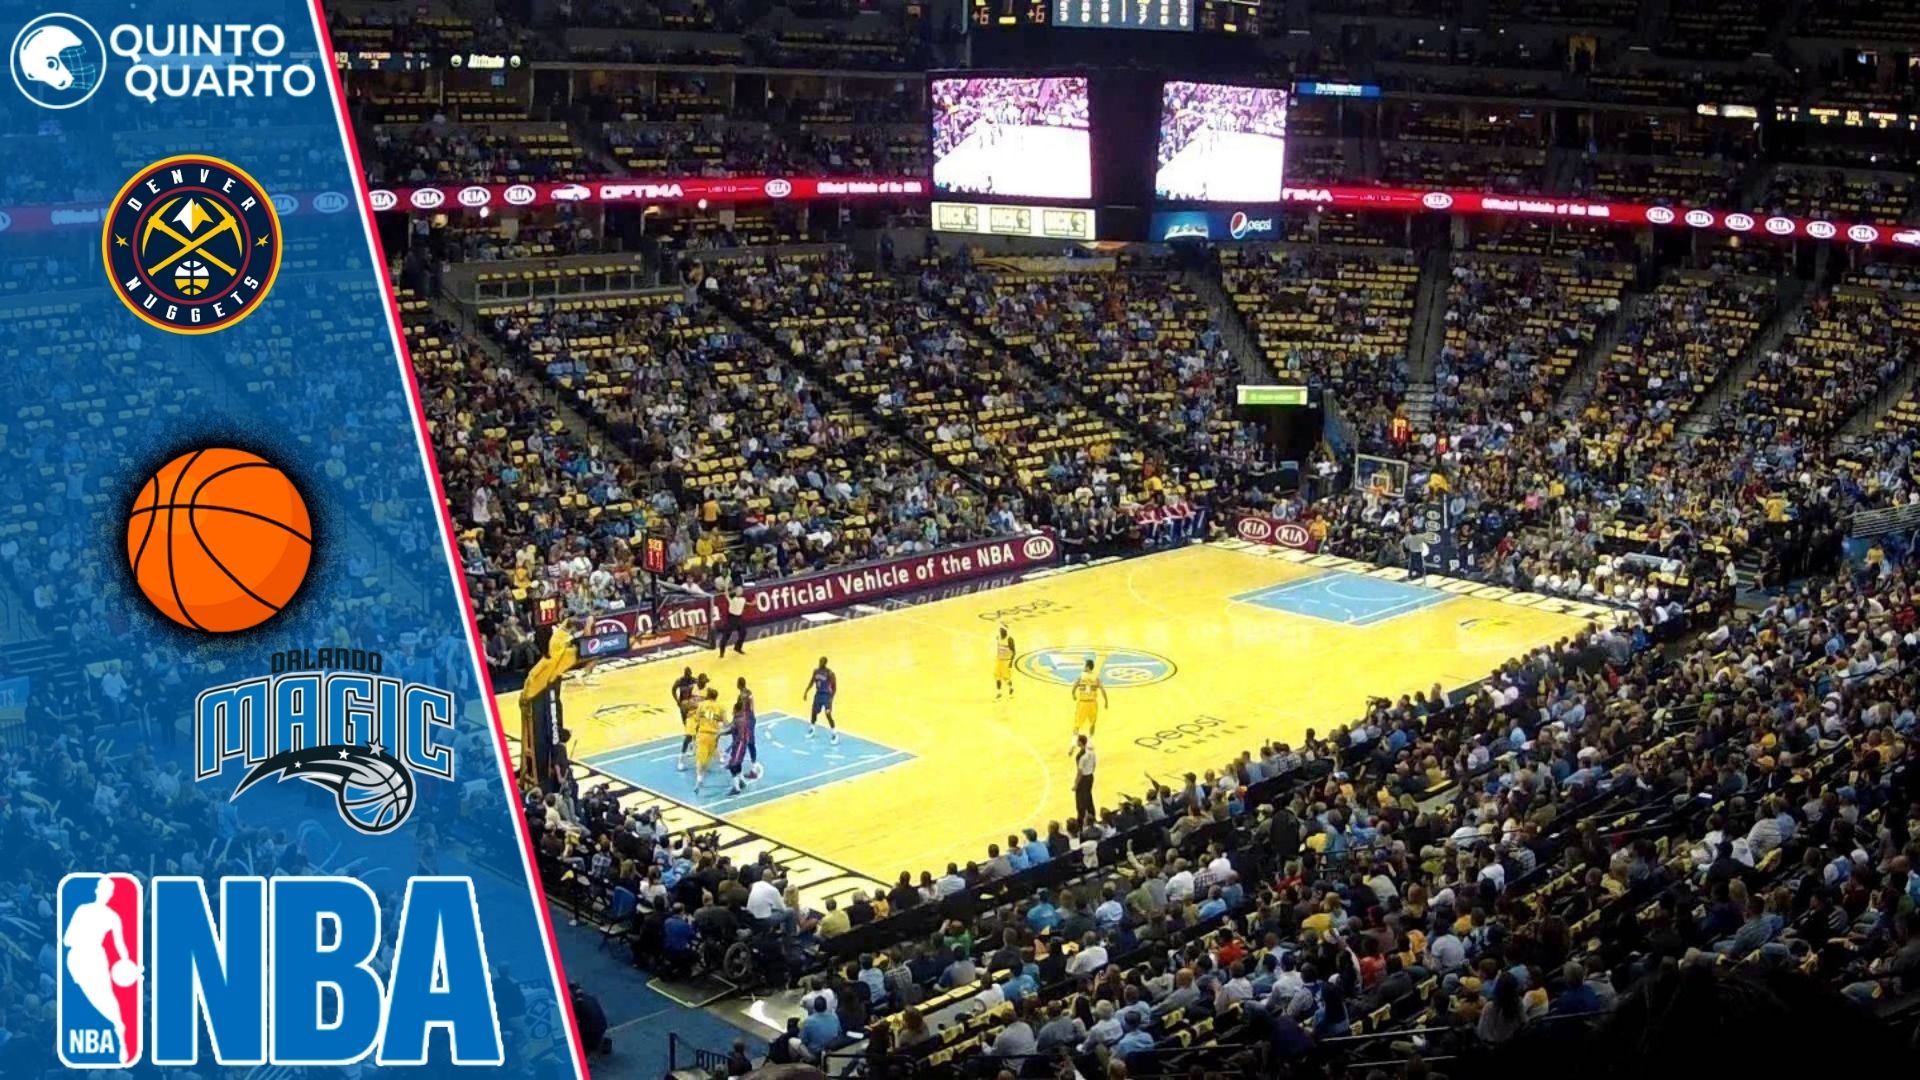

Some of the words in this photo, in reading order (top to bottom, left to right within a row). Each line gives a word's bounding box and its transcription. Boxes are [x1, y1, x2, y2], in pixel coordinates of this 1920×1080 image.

[600, 185, 684, 199] OPTIMA
[637, 606, 720, 635] Otima
[756, 579, 833, 612] Official
[838, 566, 909, 595] Vehicle
[916, 557, 934, 580] of
[941, 554, 971, 575] the
[977, 543, 1014, 568] NBA
